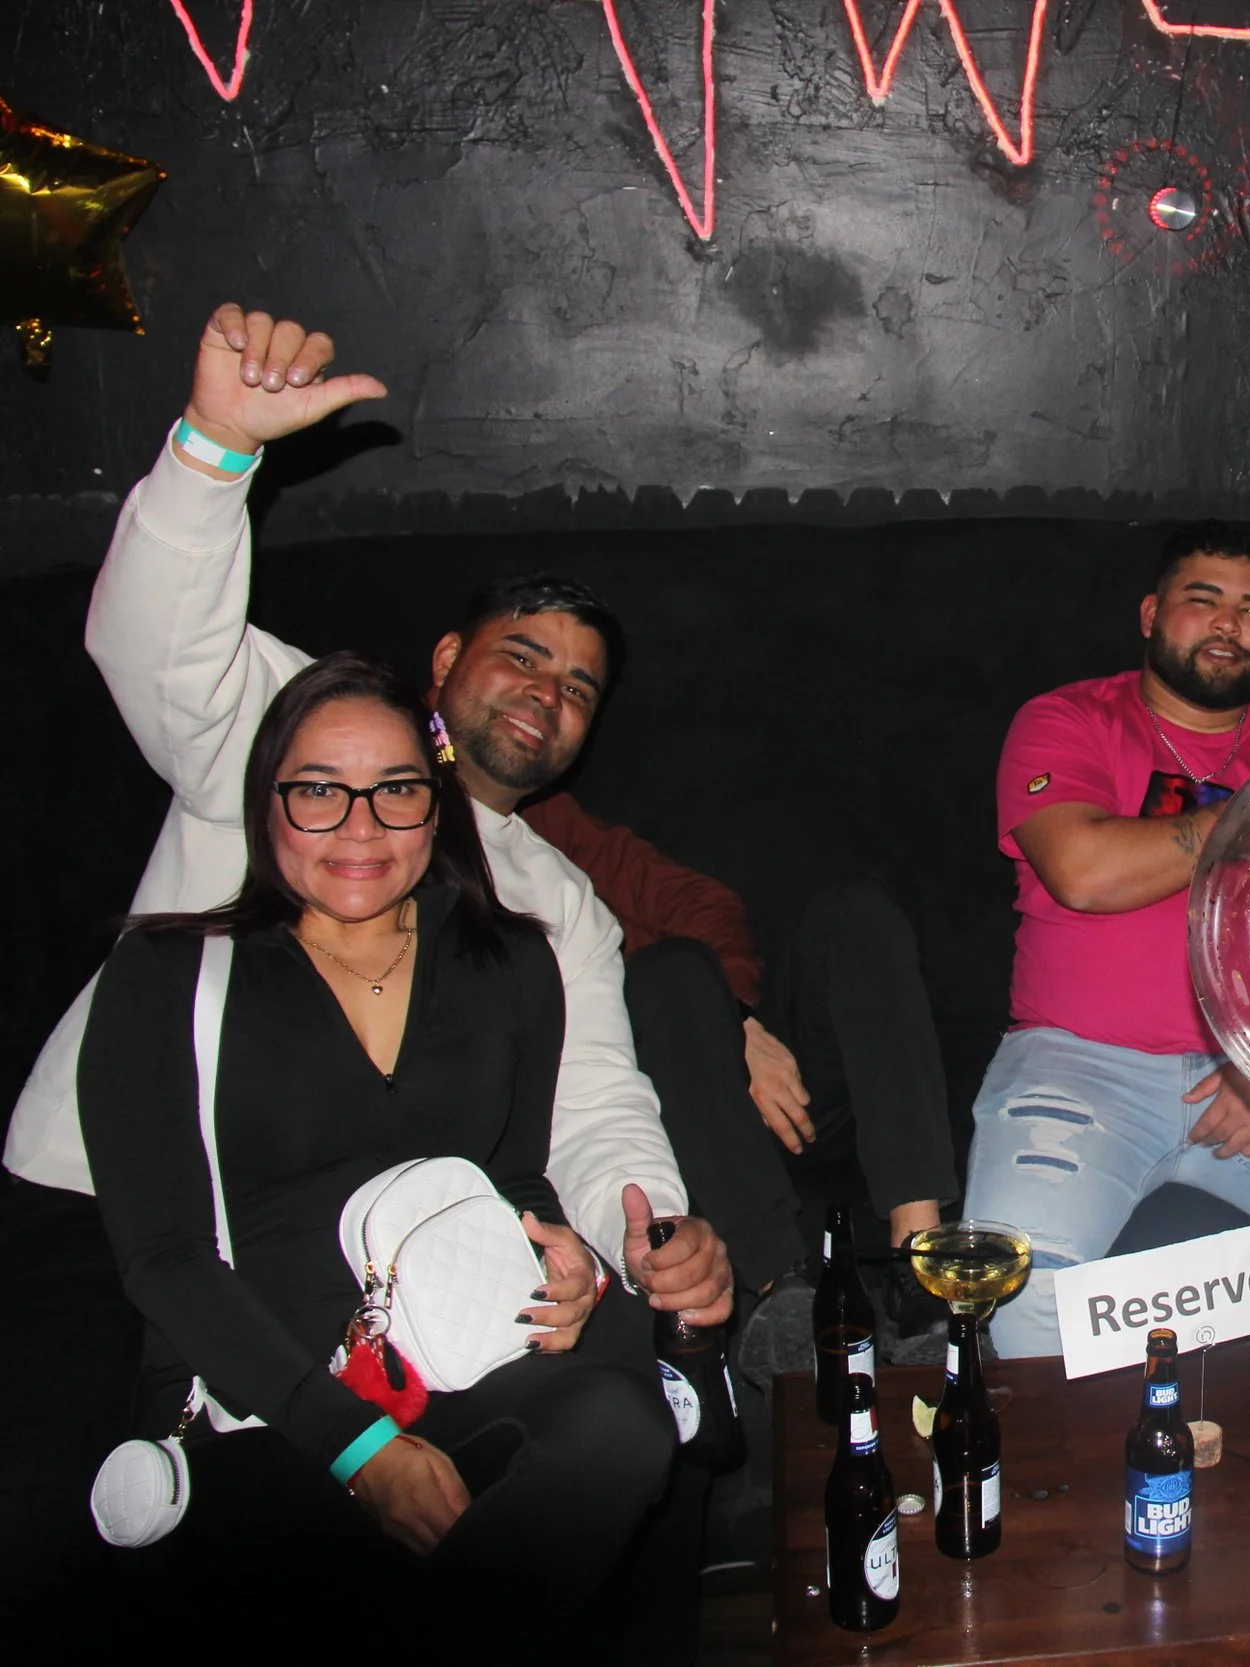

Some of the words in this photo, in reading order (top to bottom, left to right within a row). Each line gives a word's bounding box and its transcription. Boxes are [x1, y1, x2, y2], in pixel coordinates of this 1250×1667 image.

[1152, 1391, 1178, 1404] LIGHT
[1155, 1387, 1175, 1397] BUD
[667, 1394, 693, 1409] RA
[1146, 1496, 1190, 1520] BUD
[1138, 1507, 1192, 1536] LIGHT
